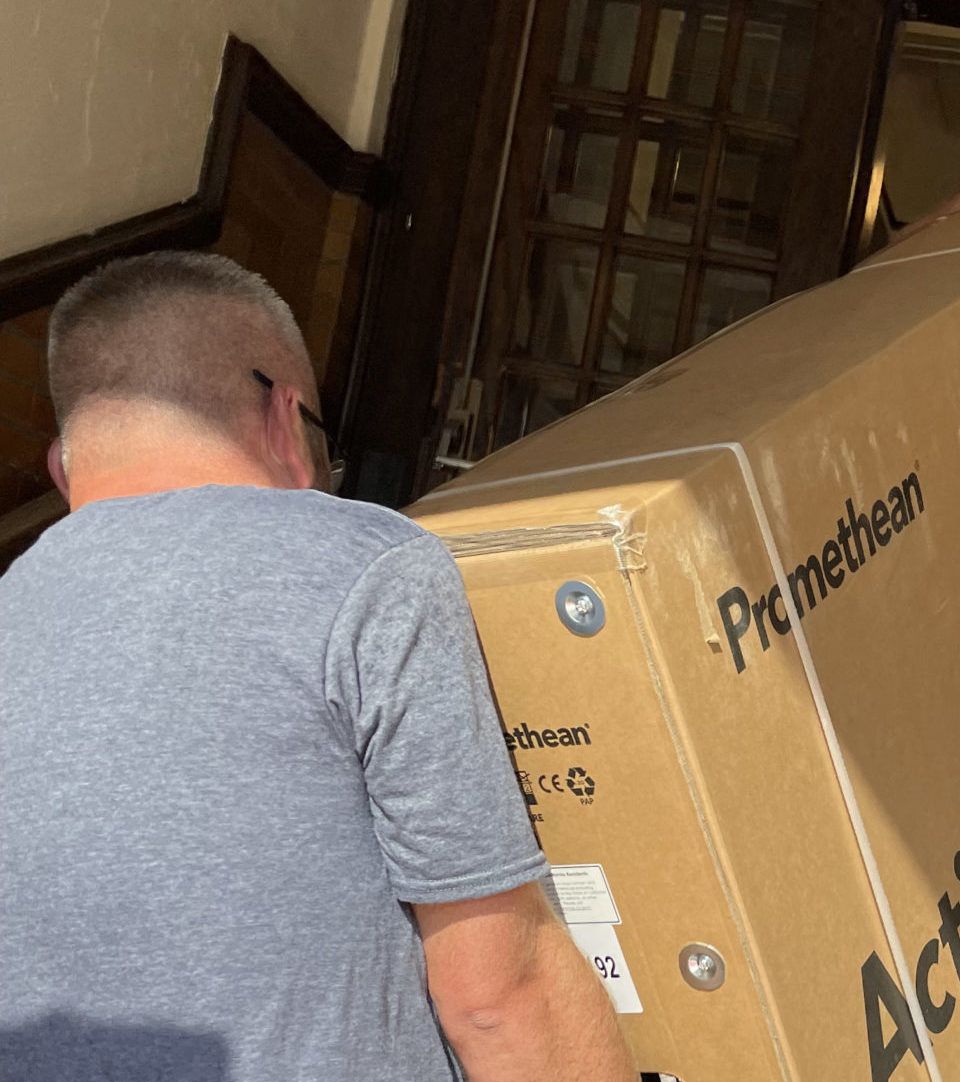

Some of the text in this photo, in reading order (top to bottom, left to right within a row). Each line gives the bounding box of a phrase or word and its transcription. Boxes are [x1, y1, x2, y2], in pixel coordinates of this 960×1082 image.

[716, 471, 925, 675] Promethean
[503, 722, 592, 750] ethean
[594, 956, 620, 979] 92
